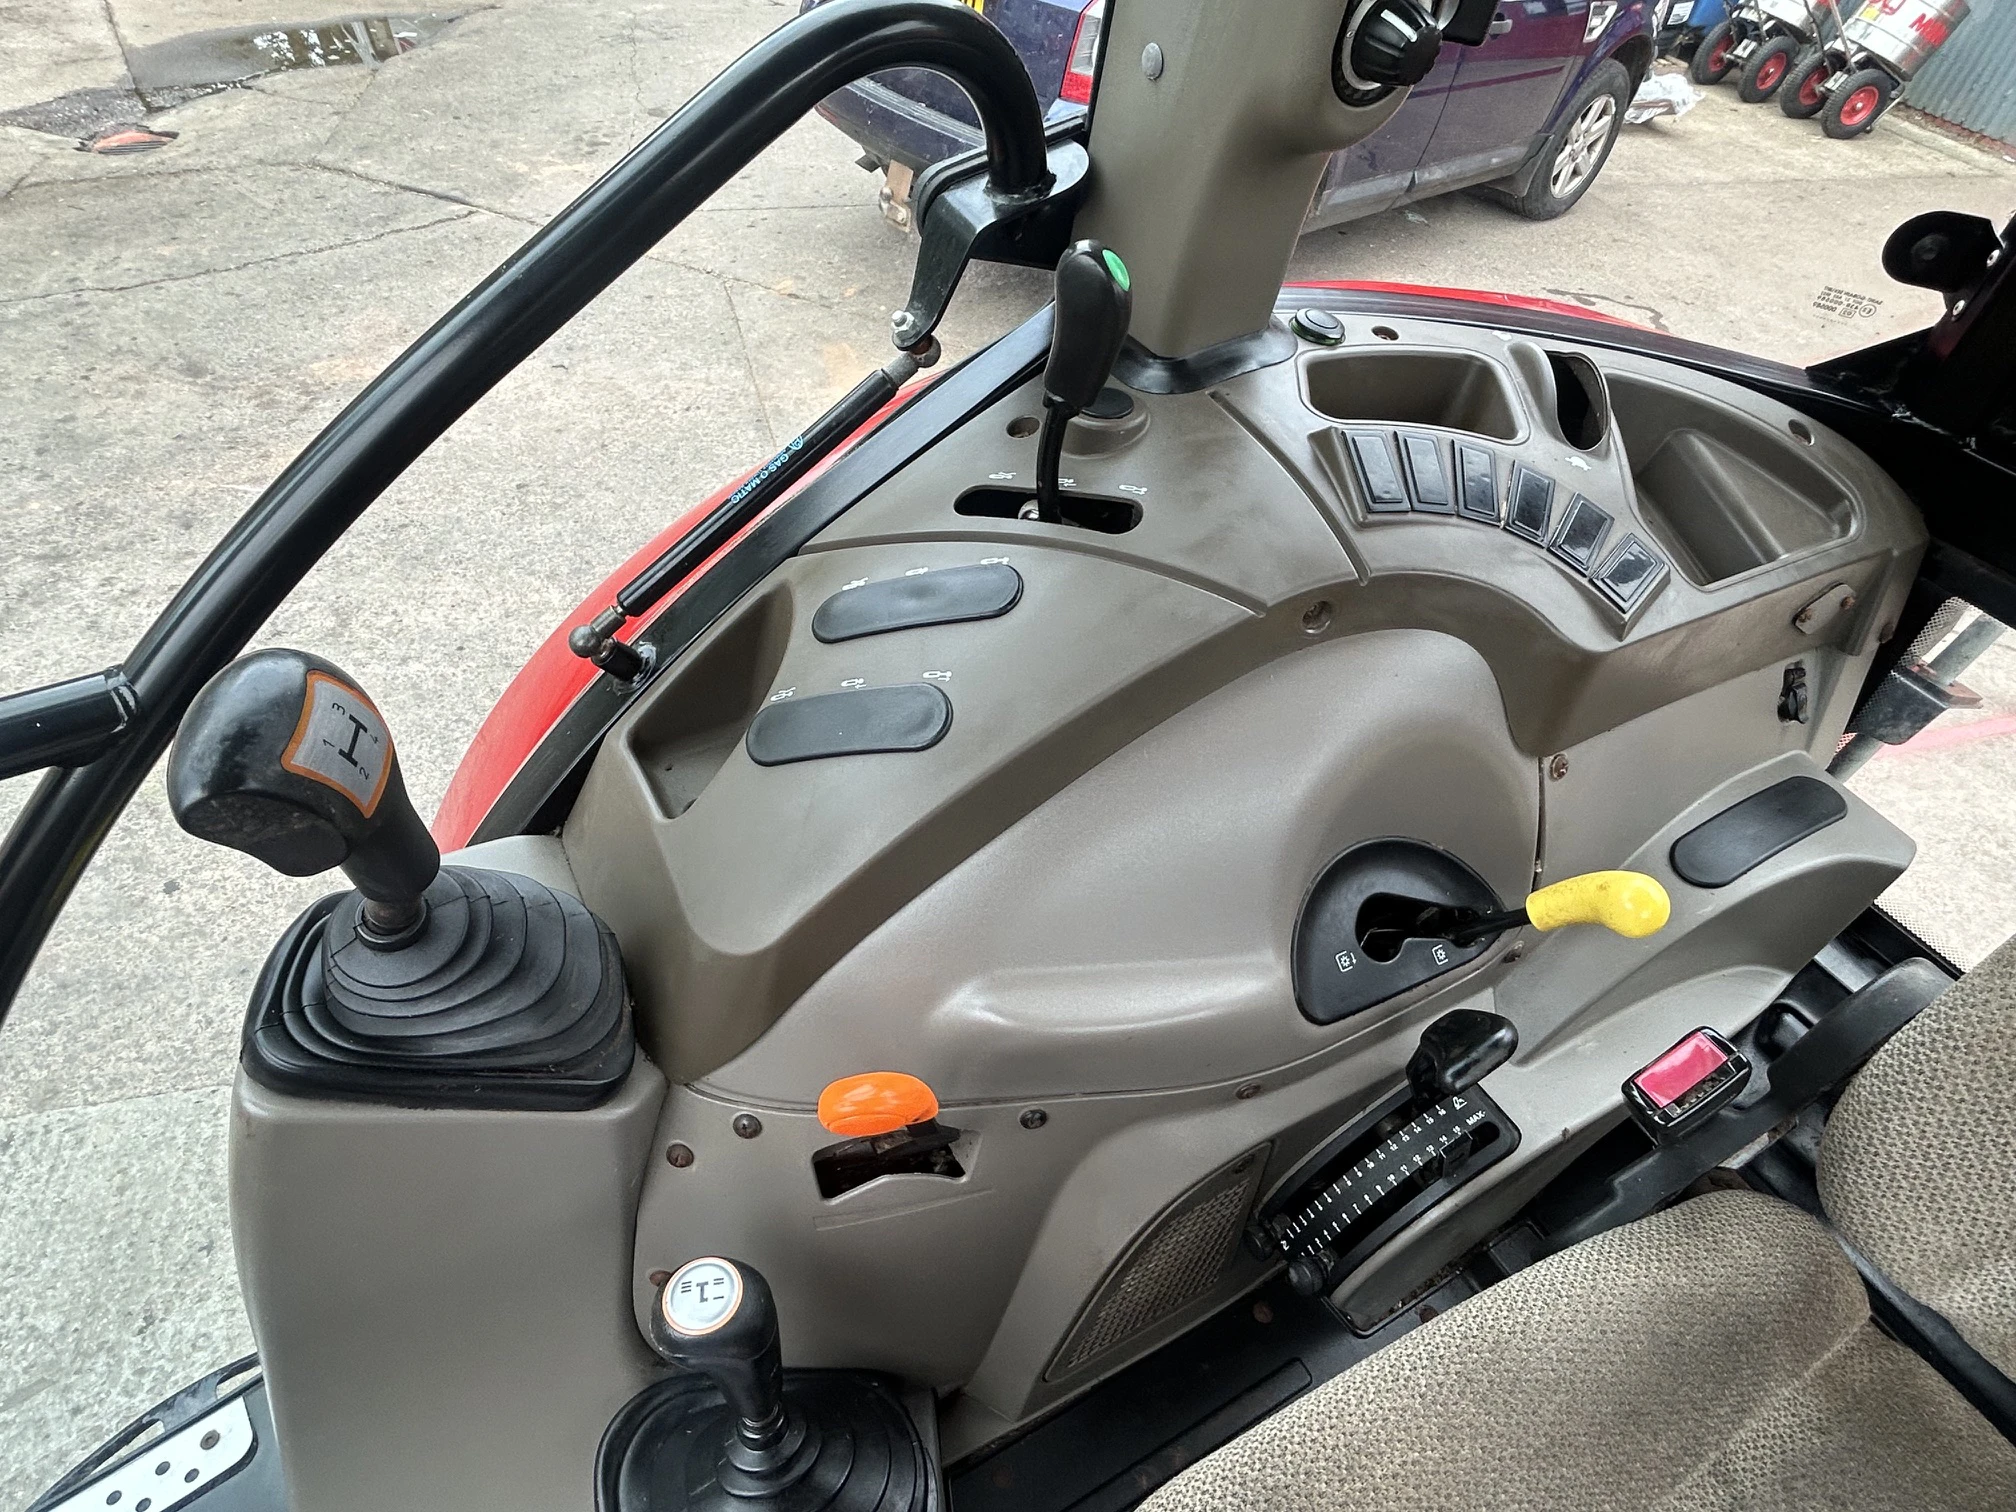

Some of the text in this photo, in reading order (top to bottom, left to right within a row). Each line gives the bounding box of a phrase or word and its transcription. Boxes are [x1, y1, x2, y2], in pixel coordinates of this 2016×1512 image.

[331, 702, 346, 715] 3
[322, 739, 335, 748] 1
[359, 767, 370, 780] 2
